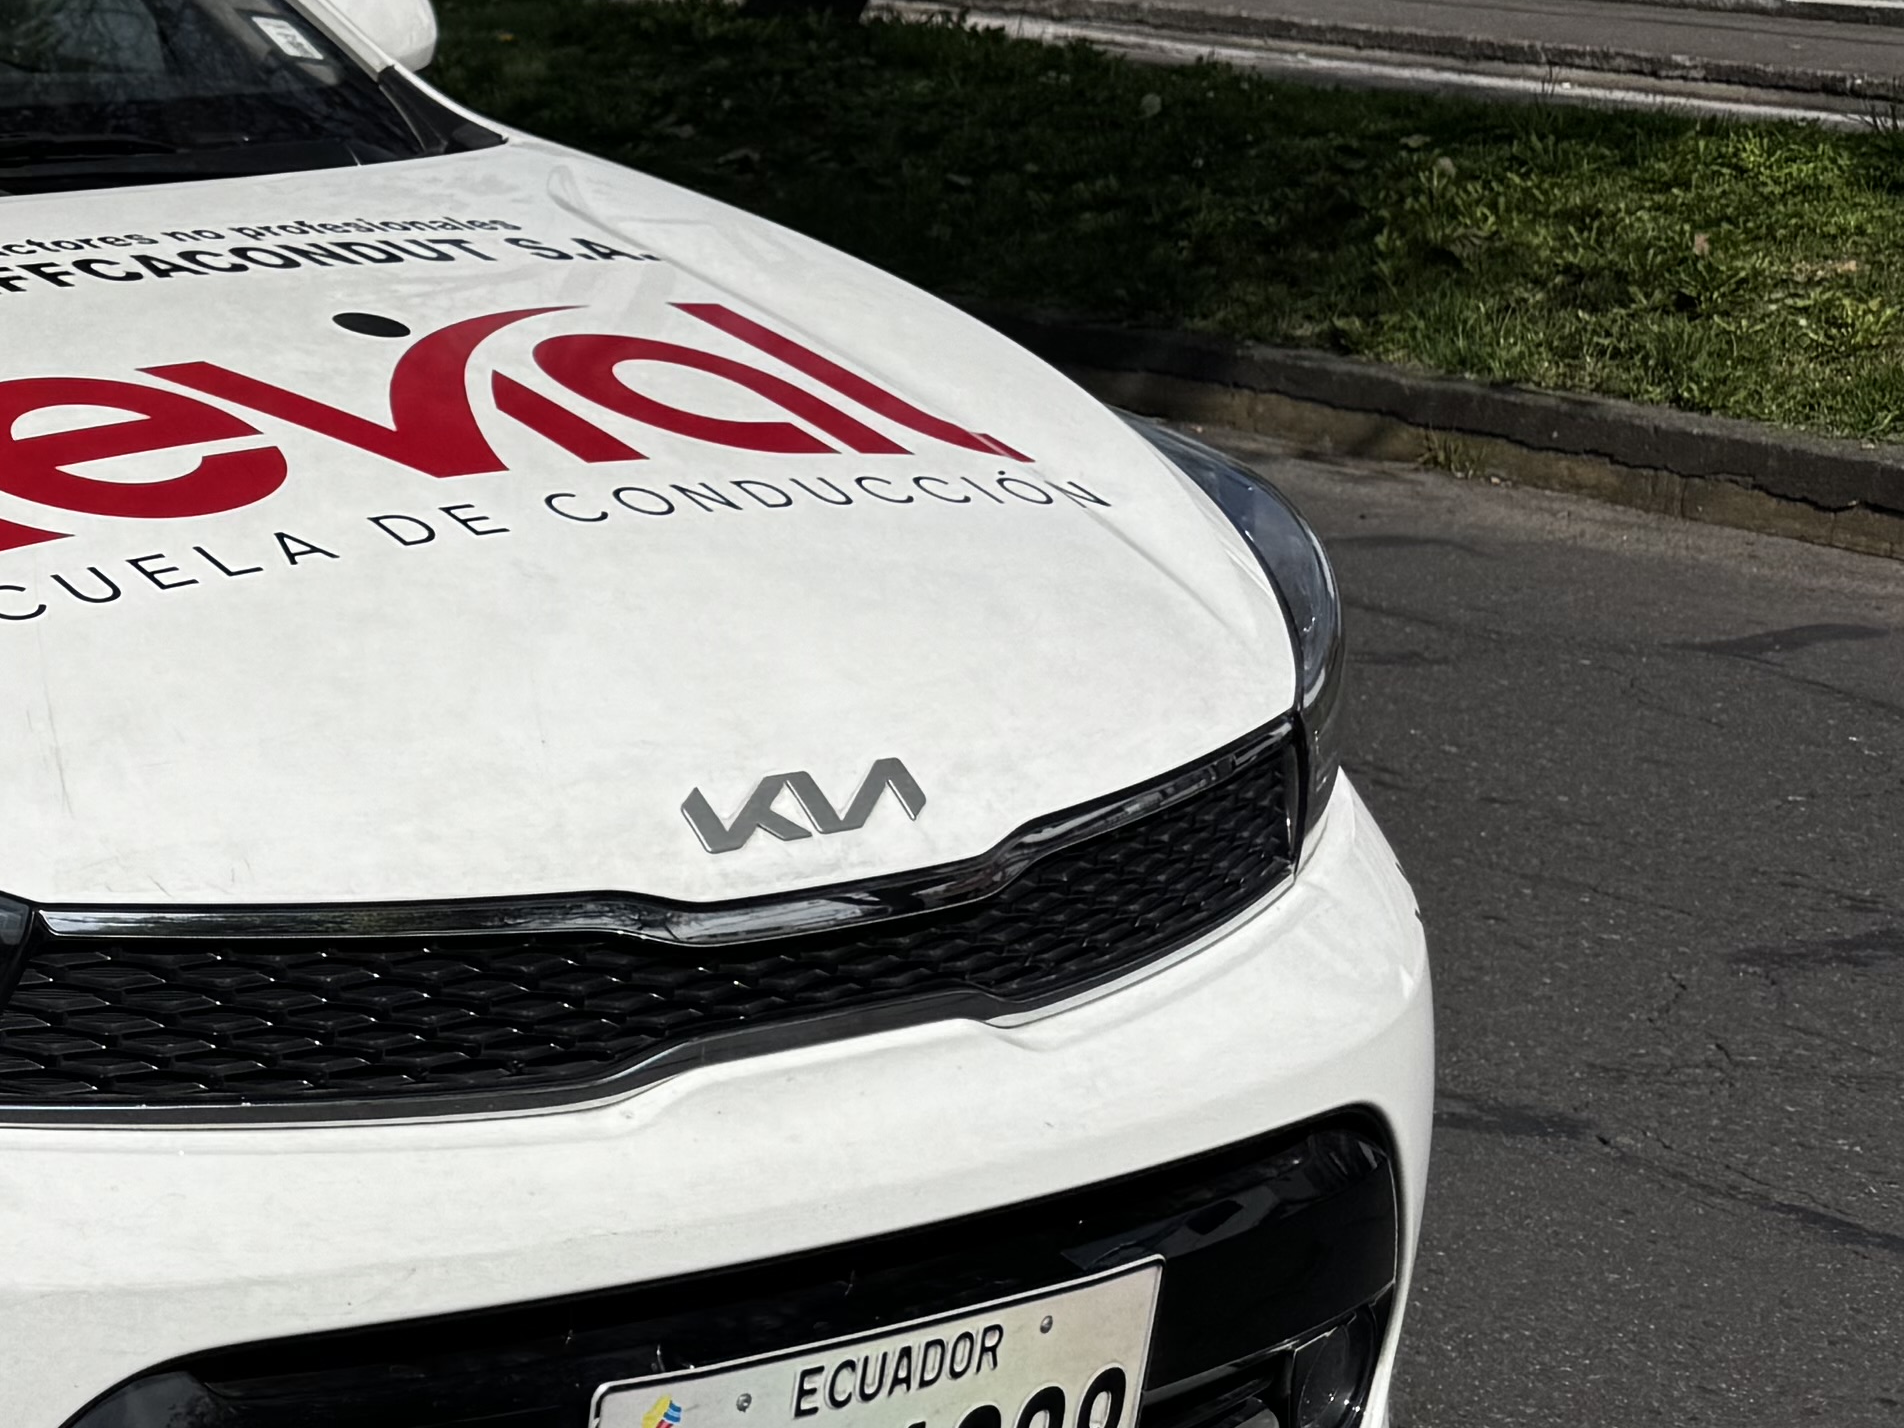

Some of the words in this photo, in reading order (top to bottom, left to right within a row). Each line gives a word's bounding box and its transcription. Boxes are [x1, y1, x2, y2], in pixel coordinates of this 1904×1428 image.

[160, 228, 226, 243] no
[228, 215, 523, 242] profesionales
[503, 237, 662, 262] S.A.
[368, 503, 513, 547] DE
[543, 470, 1113, 524] CONDUCCIÓN
[679, 756, 928, 856] KIA
[793, 1323, 1005, 1419] ECUADOR
